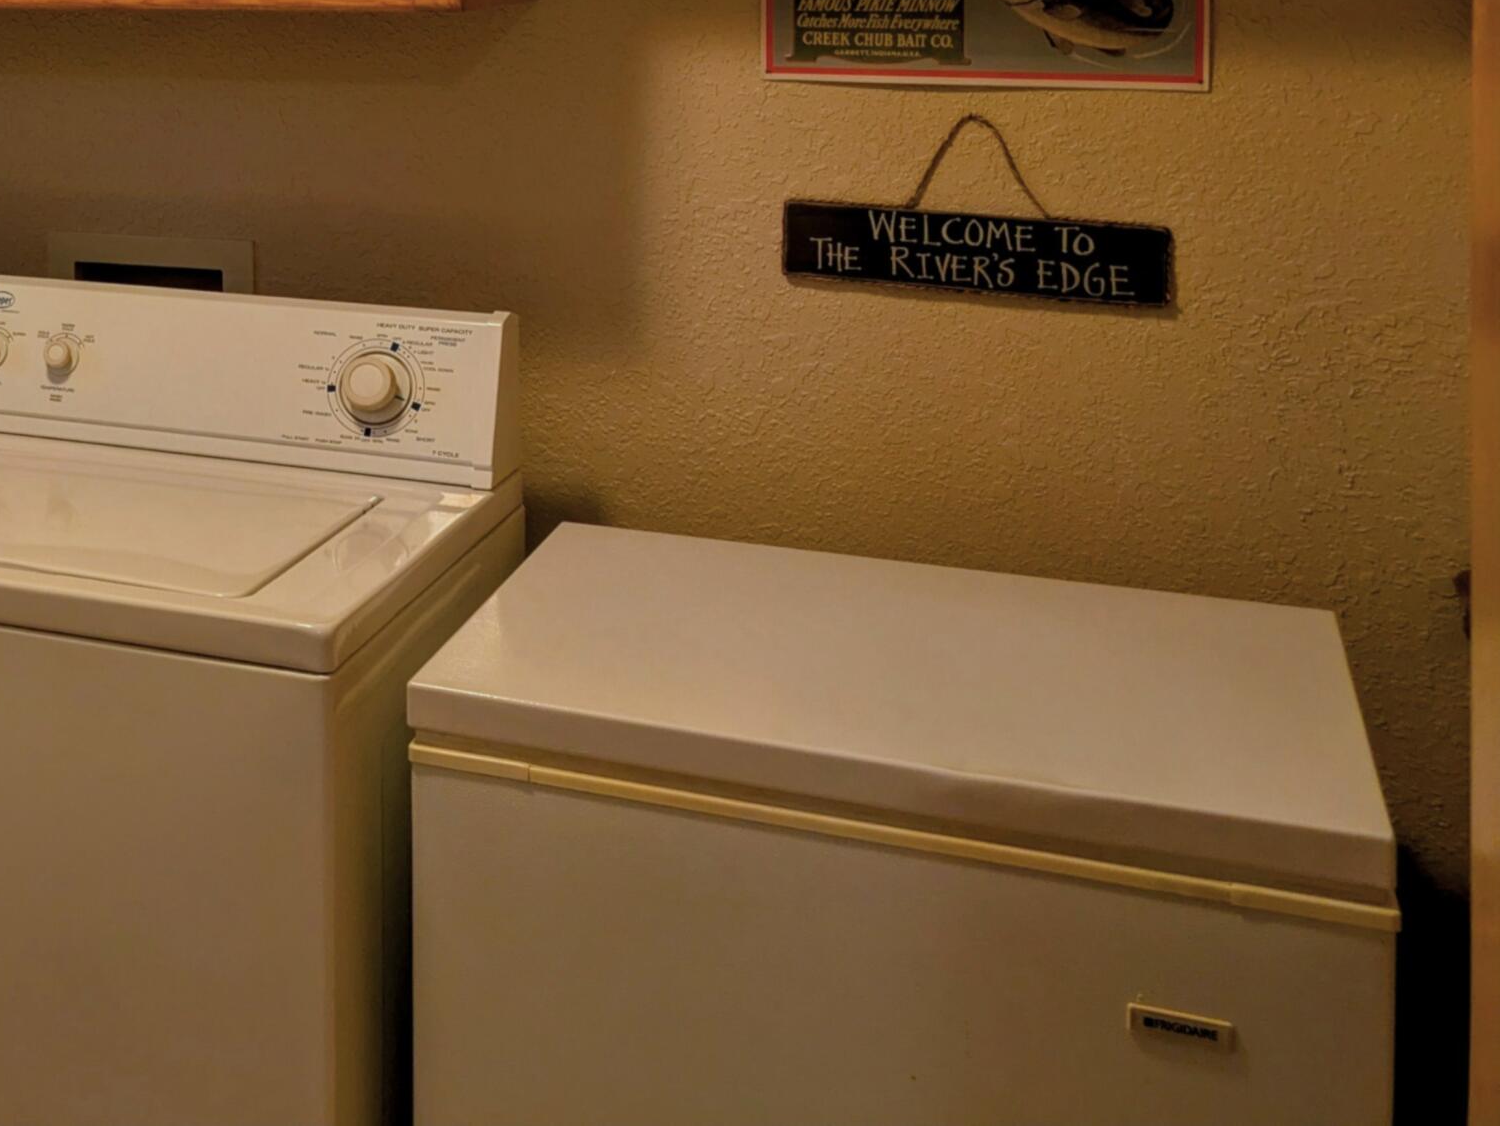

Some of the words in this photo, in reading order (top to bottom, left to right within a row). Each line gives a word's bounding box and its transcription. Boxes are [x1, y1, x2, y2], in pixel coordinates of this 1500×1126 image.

[797, 13, 839, 28] Catches
[838, 13, 867, 28] More
[866, 13, 890, 29] Fish
[890, 15, 960, 32] Everywhere
[802, 31, 851, 46] CREEK
[854, 32, 894, 47] CHUB
[897, 34, 927, 48] BAIT
[929, 34, 954, 48] CO.
[868, 210, 1036, 253] WELCOME
[1054, 226, 1096, 256] TO
[810, 237, 862, 272] THE
[890, 245, 1016, 290] RIVER'S
[1036, 260, 1136, 297] EDGE
[418, 325, 440, 333] SUPER
[440, 327, 473, 336] CAPACITY
